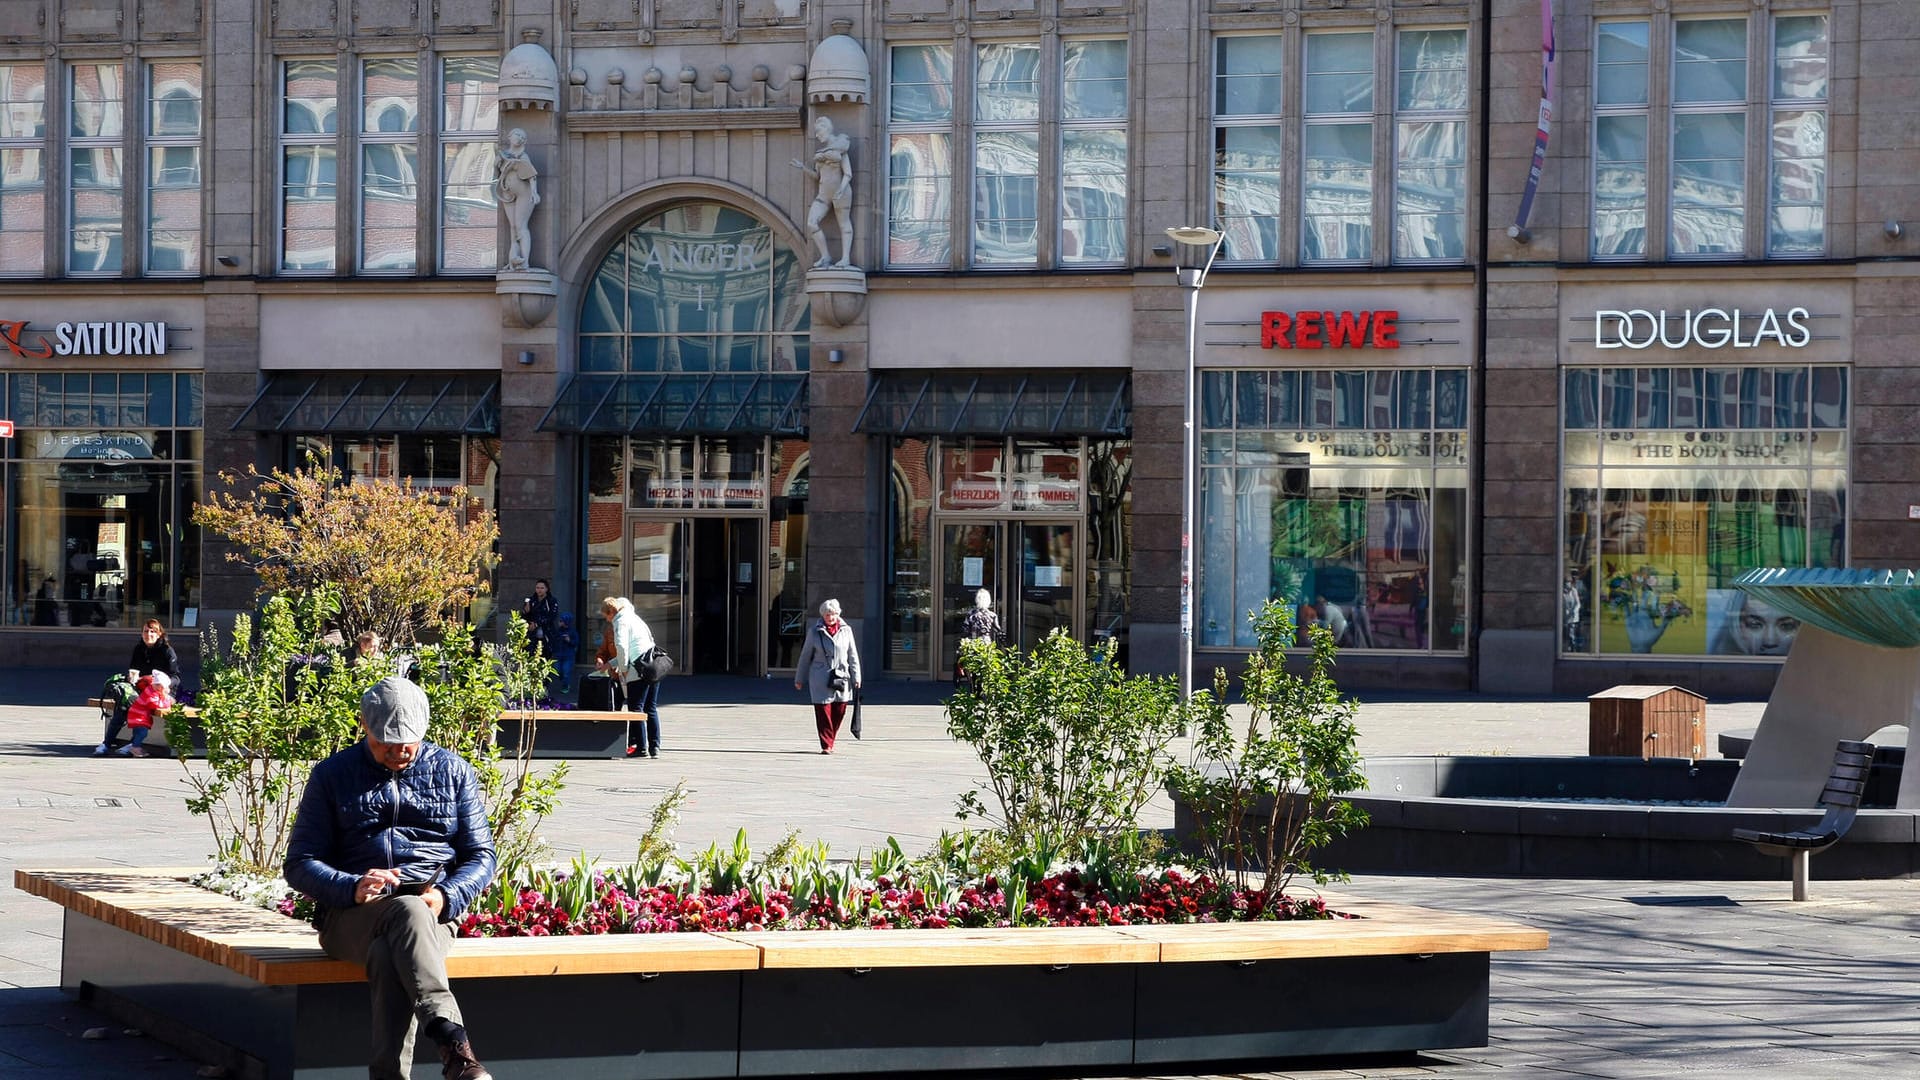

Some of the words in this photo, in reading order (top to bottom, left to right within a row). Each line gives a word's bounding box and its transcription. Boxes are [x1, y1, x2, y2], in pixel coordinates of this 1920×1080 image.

[642, 243, 757, 272] ANGER
[1261, 311, 1400, 349] REWE
[1595, 307, 1811, 349] DOUGLAS
[55, 321, 167, 356] SATURN
[43, 436, 144, 445] LIEBESKIND
[1321, 444, 1357, 457] THE
[1364, 444, 1412, 457] BODY
[1633, 444, 1673, 458] THE
[1679, 444, 1728, 458] BODY
[1734, 444, 1785, 458] SHOP
[648, 487, 694, 499] HERZLICH
[953, 489, 1000, 500] HERZLICH
